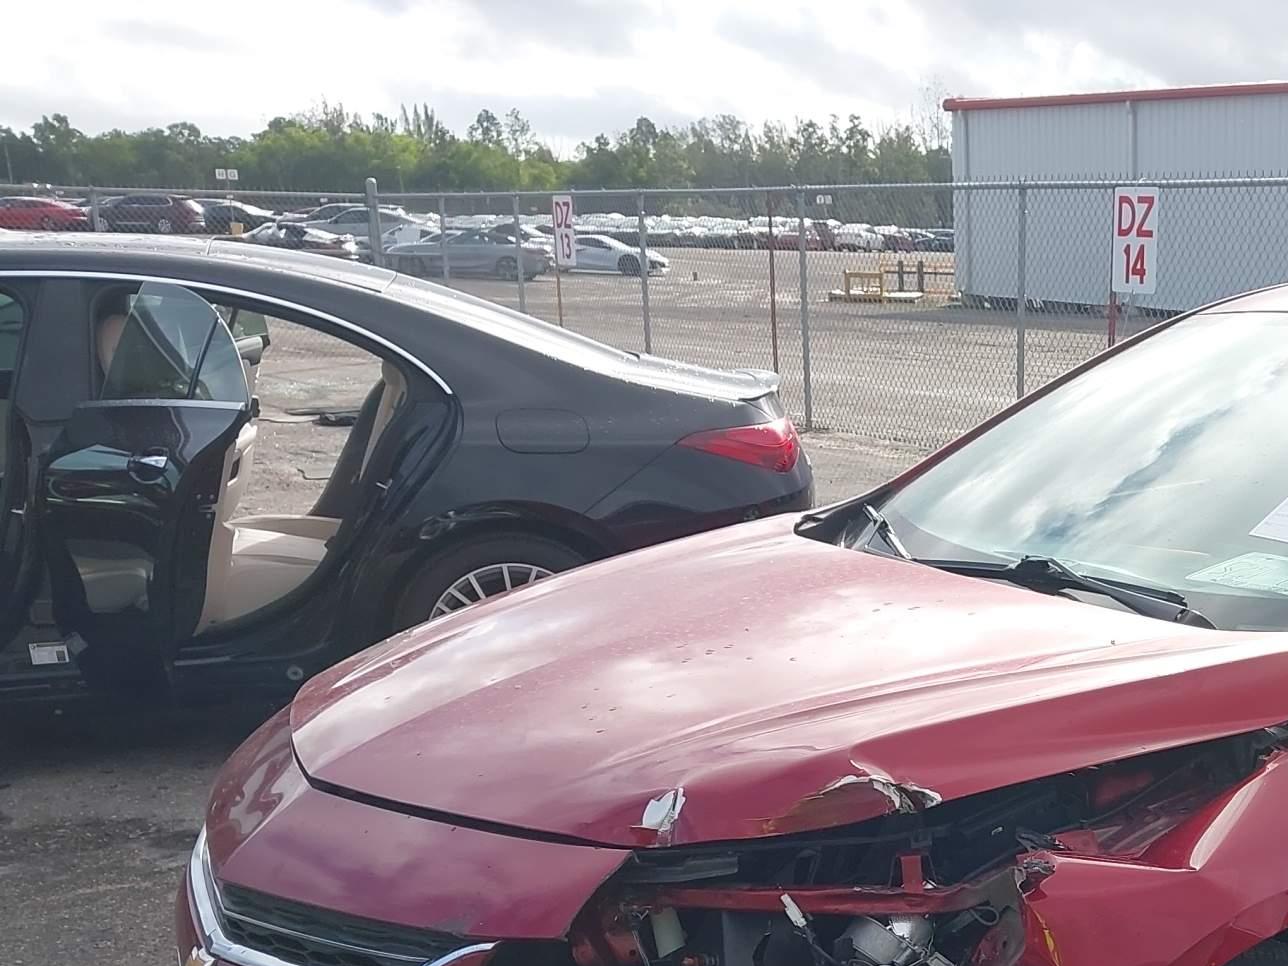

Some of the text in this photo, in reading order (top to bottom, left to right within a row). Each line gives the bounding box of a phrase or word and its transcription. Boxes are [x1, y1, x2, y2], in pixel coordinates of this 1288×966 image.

[555, 201, 572, 229] DZ
[1117, 195, 1155, 238] DZ
[560, 233, 572, 259] 13
[1123, 243, 1146, 285] 14
